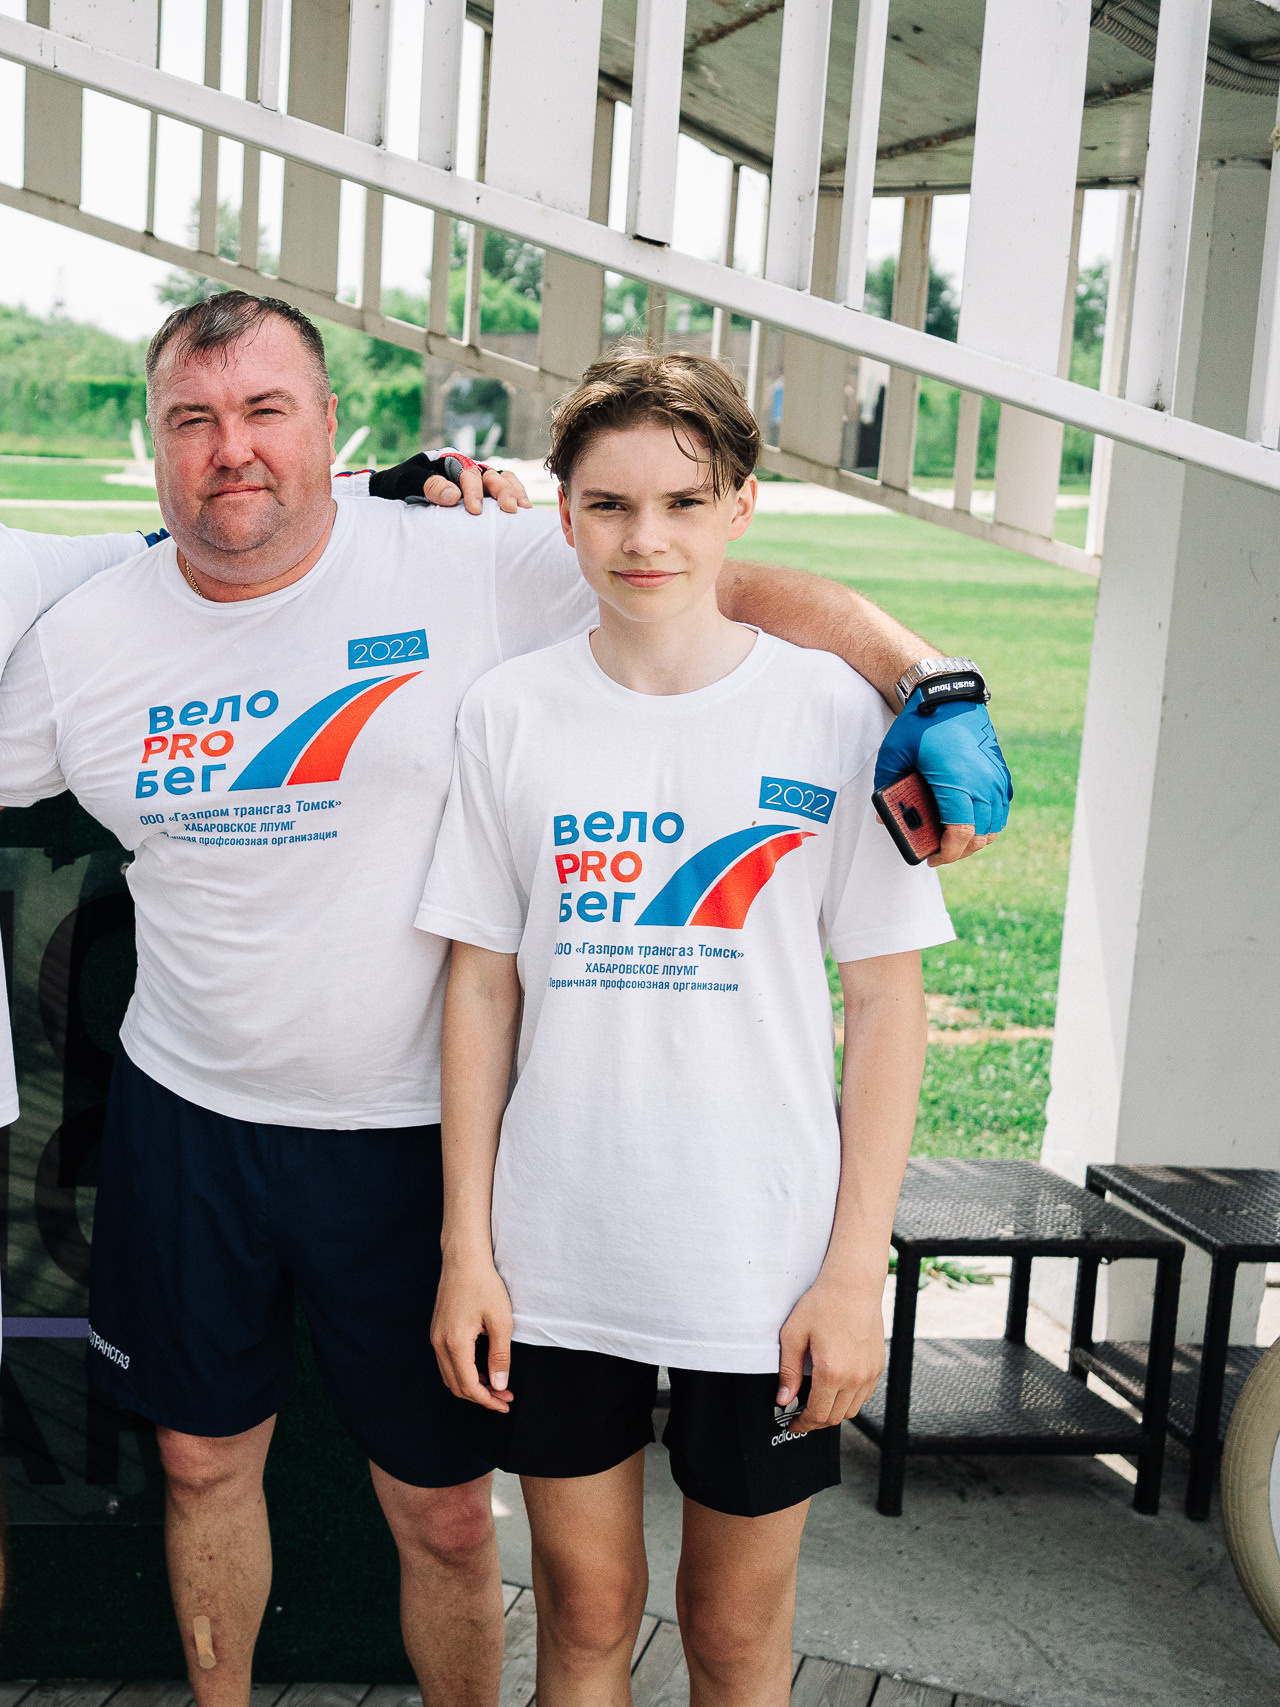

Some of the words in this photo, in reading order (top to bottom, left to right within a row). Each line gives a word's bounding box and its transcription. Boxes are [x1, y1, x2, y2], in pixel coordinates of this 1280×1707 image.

[353, 635, 423, 664] 2022
[141, 730, 235, 764] PRO
[765, 783, 830, 817] 2022
[139, 813, 165, 826] ООО
[169, 806, 229, 823] «Газпром
[233, 801, 291, 818] трансгаз
[296, 799, 342, 813] Томск»
[184, 822, 257, 833] ХАБАРОВСКОЕ
[259, 820, 297, 832] ЛПУМГ
[199, 835, 268, 847] профсоюзная
[271, 830, 338, 846] организация
[554, 850, 643, 884] PRO
[575, 942, 634, 957] «Газпром
[638, 944, 694, 959] трансгаз
[699, 944, 745, 959] Томск»
[585, 962, 659, 975] ХАБАРОВСКОЕ
[662, 964, 699, 976] ЛПУМГ
[600, 978, 670, 991] профсоюзная
[672, 980, 738, 992] организация
